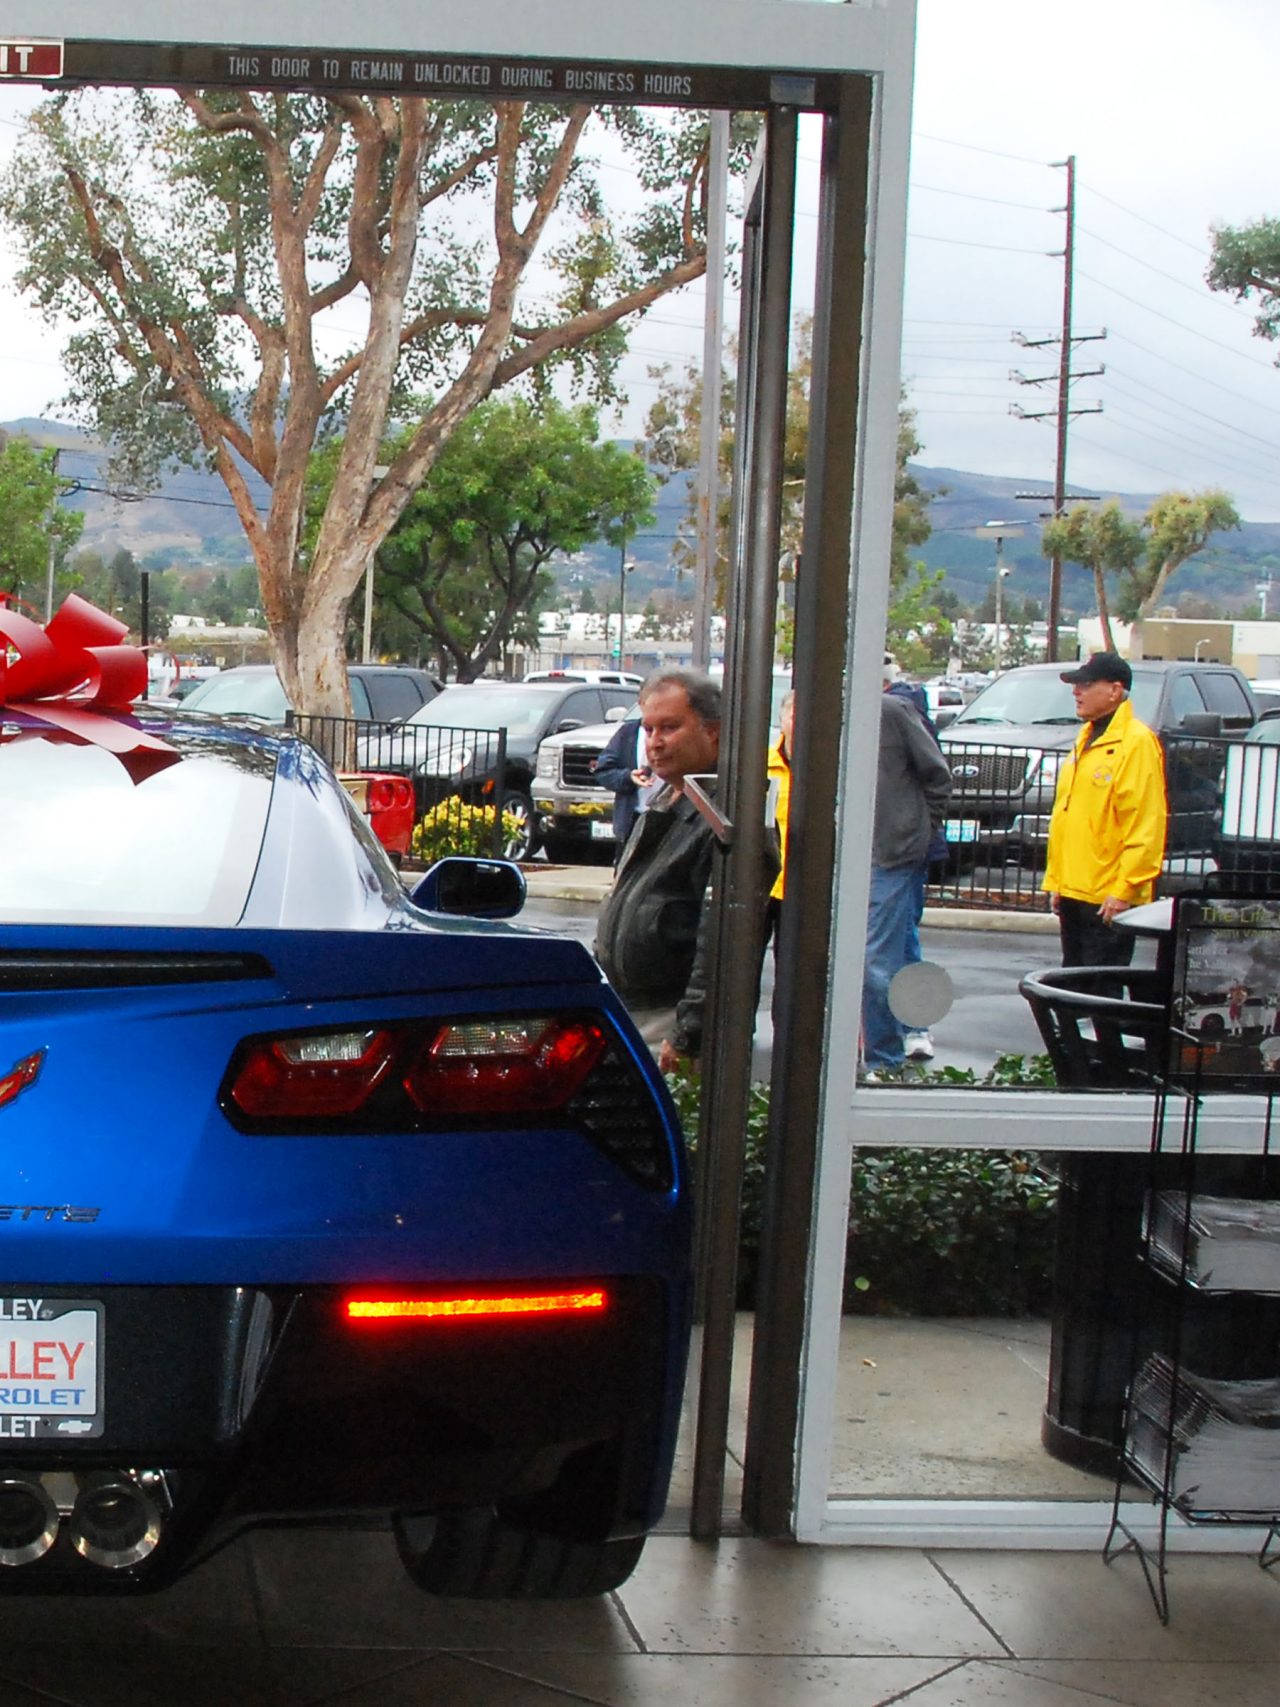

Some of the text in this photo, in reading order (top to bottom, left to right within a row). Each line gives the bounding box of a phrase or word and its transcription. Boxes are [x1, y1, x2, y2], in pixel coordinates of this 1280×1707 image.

[228, 56, 692, 96] THIS DOOR TO REMAIN UNLOCKED DURING BUSINESS HOURS
[1200, 906, 1233, 922] The
